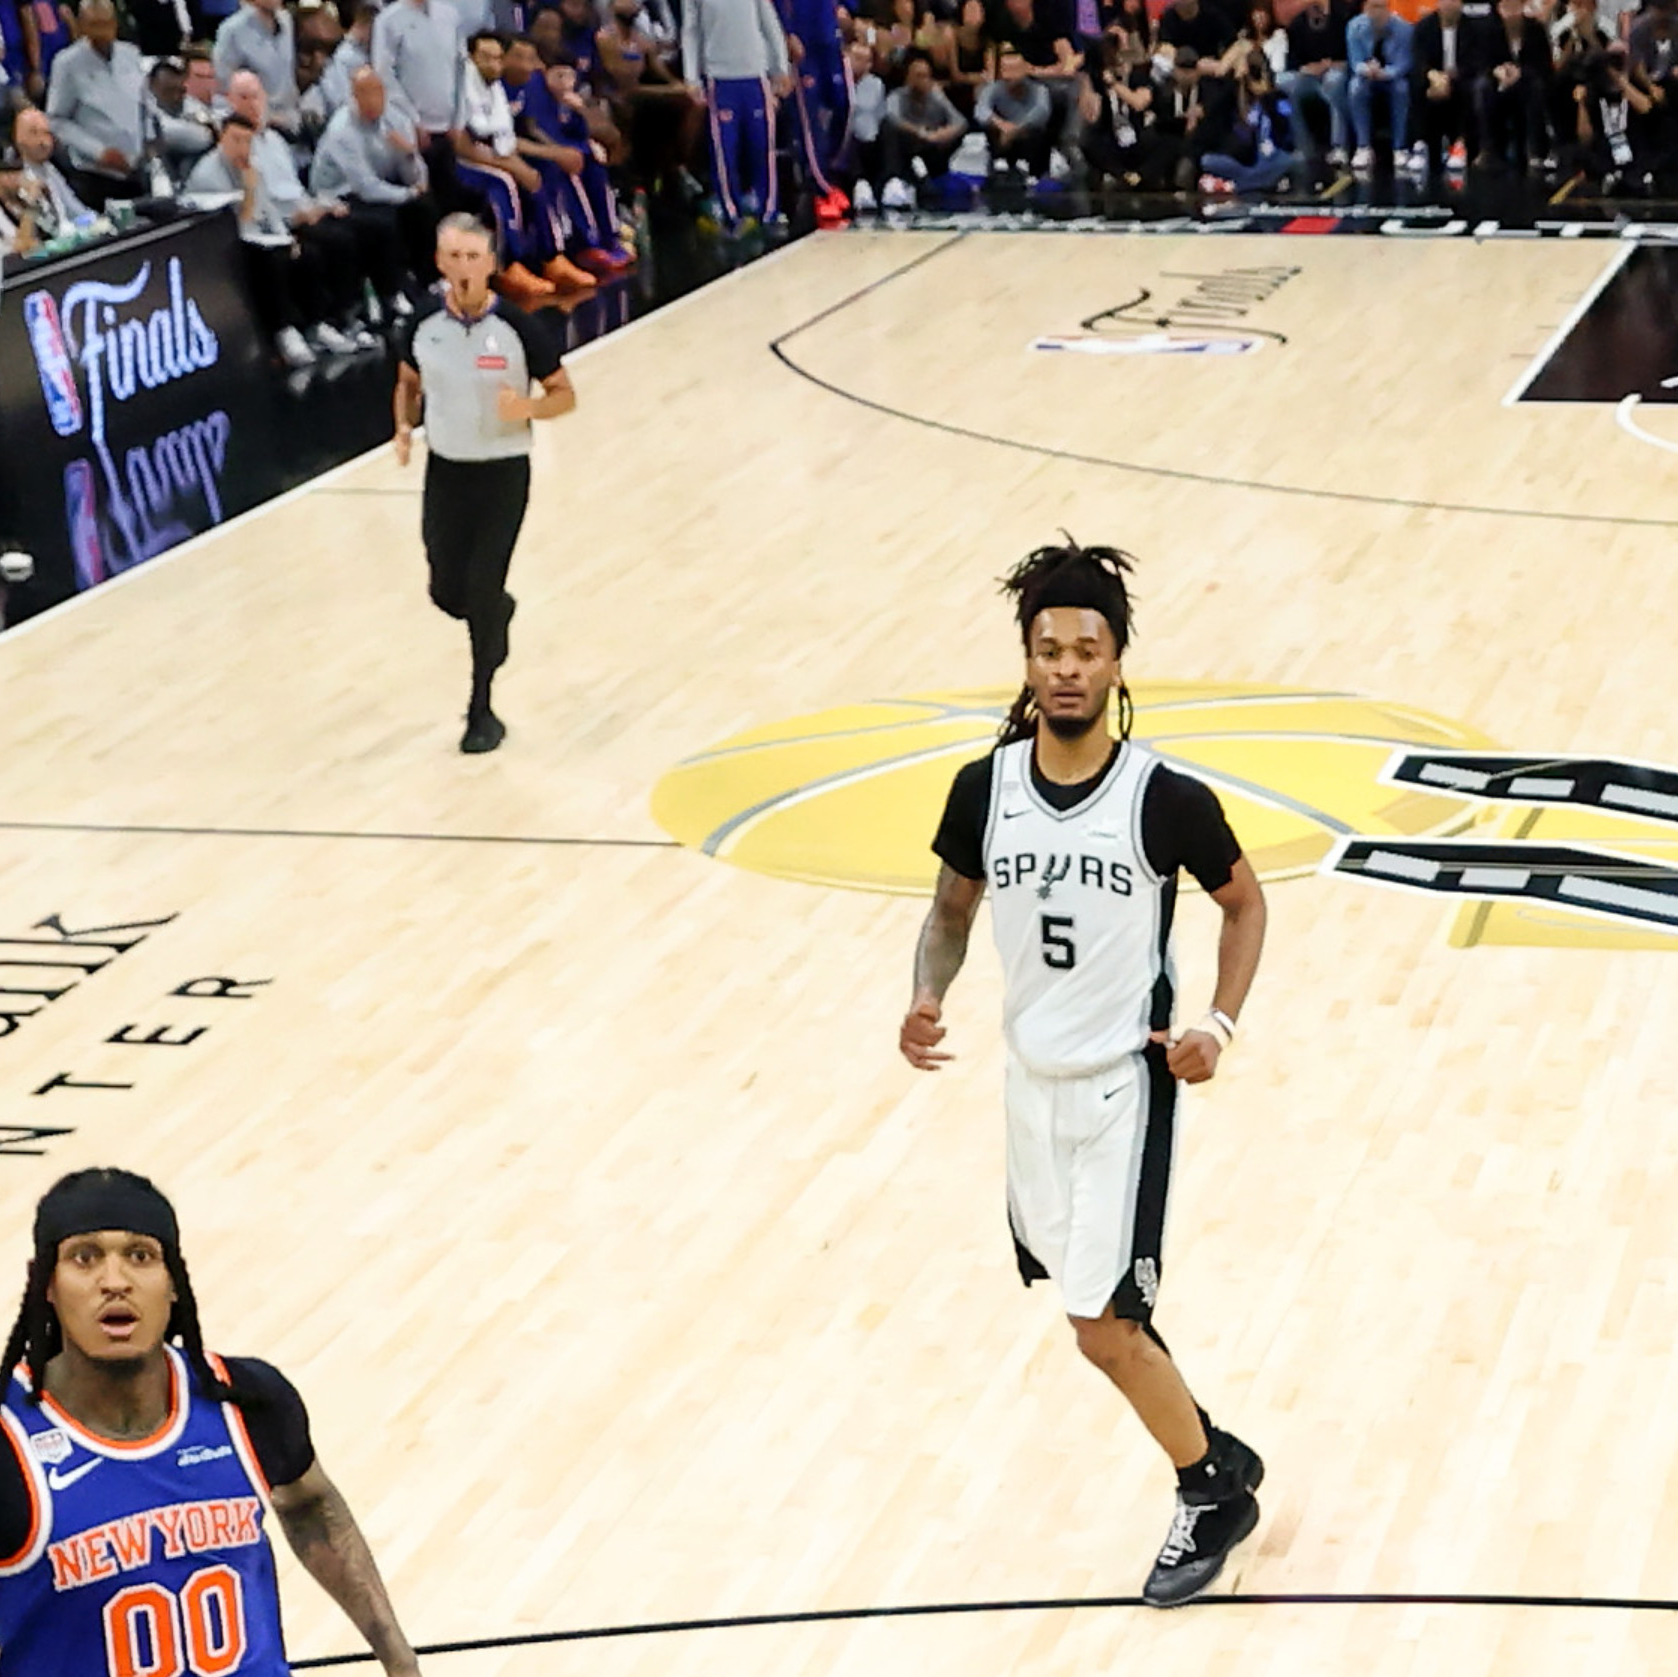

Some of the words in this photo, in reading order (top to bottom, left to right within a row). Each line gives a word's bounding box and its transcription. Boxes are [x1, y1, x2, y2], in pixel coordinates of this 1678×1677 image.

[61, 256, 219, 444] Finals
[994, 853, 1133, 900] SPURS
[1041, 913, 1076, 970] 5
[47, 1514, 153, 1592] NEW
[151, 1496, 263, 1559] YORK
